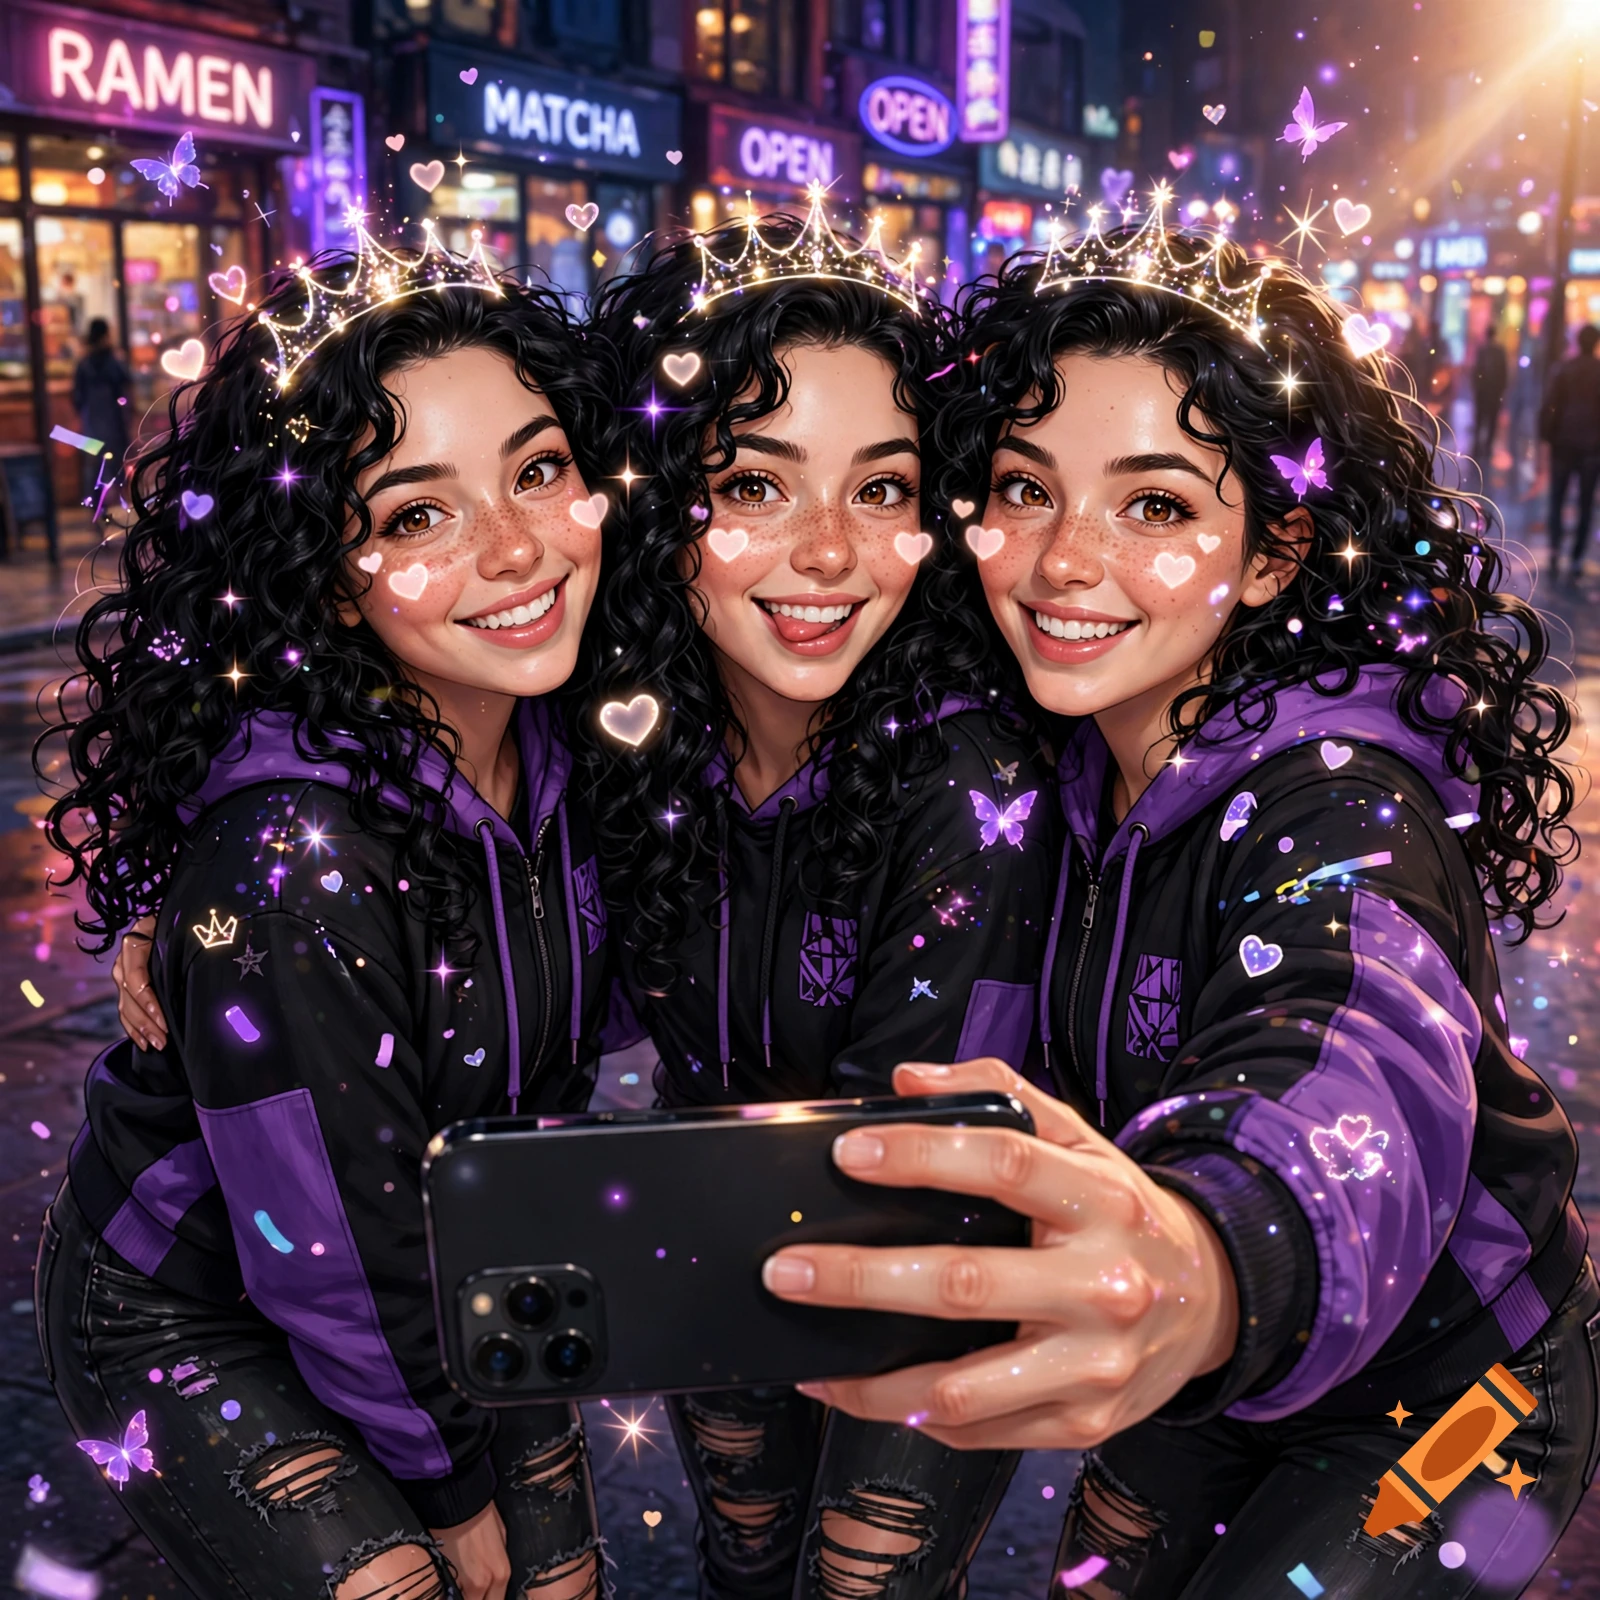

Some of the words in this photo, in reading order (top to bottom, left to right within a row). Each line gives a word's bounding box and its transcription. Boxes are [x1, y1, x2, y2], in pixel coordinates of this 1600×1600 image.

[49, 28, 272, 128] RAMEN
[484, 81, 641, 158] MATCHA
[868, 87, 949, 143] OPEN
[740, 127, 833, 184] OPEN
